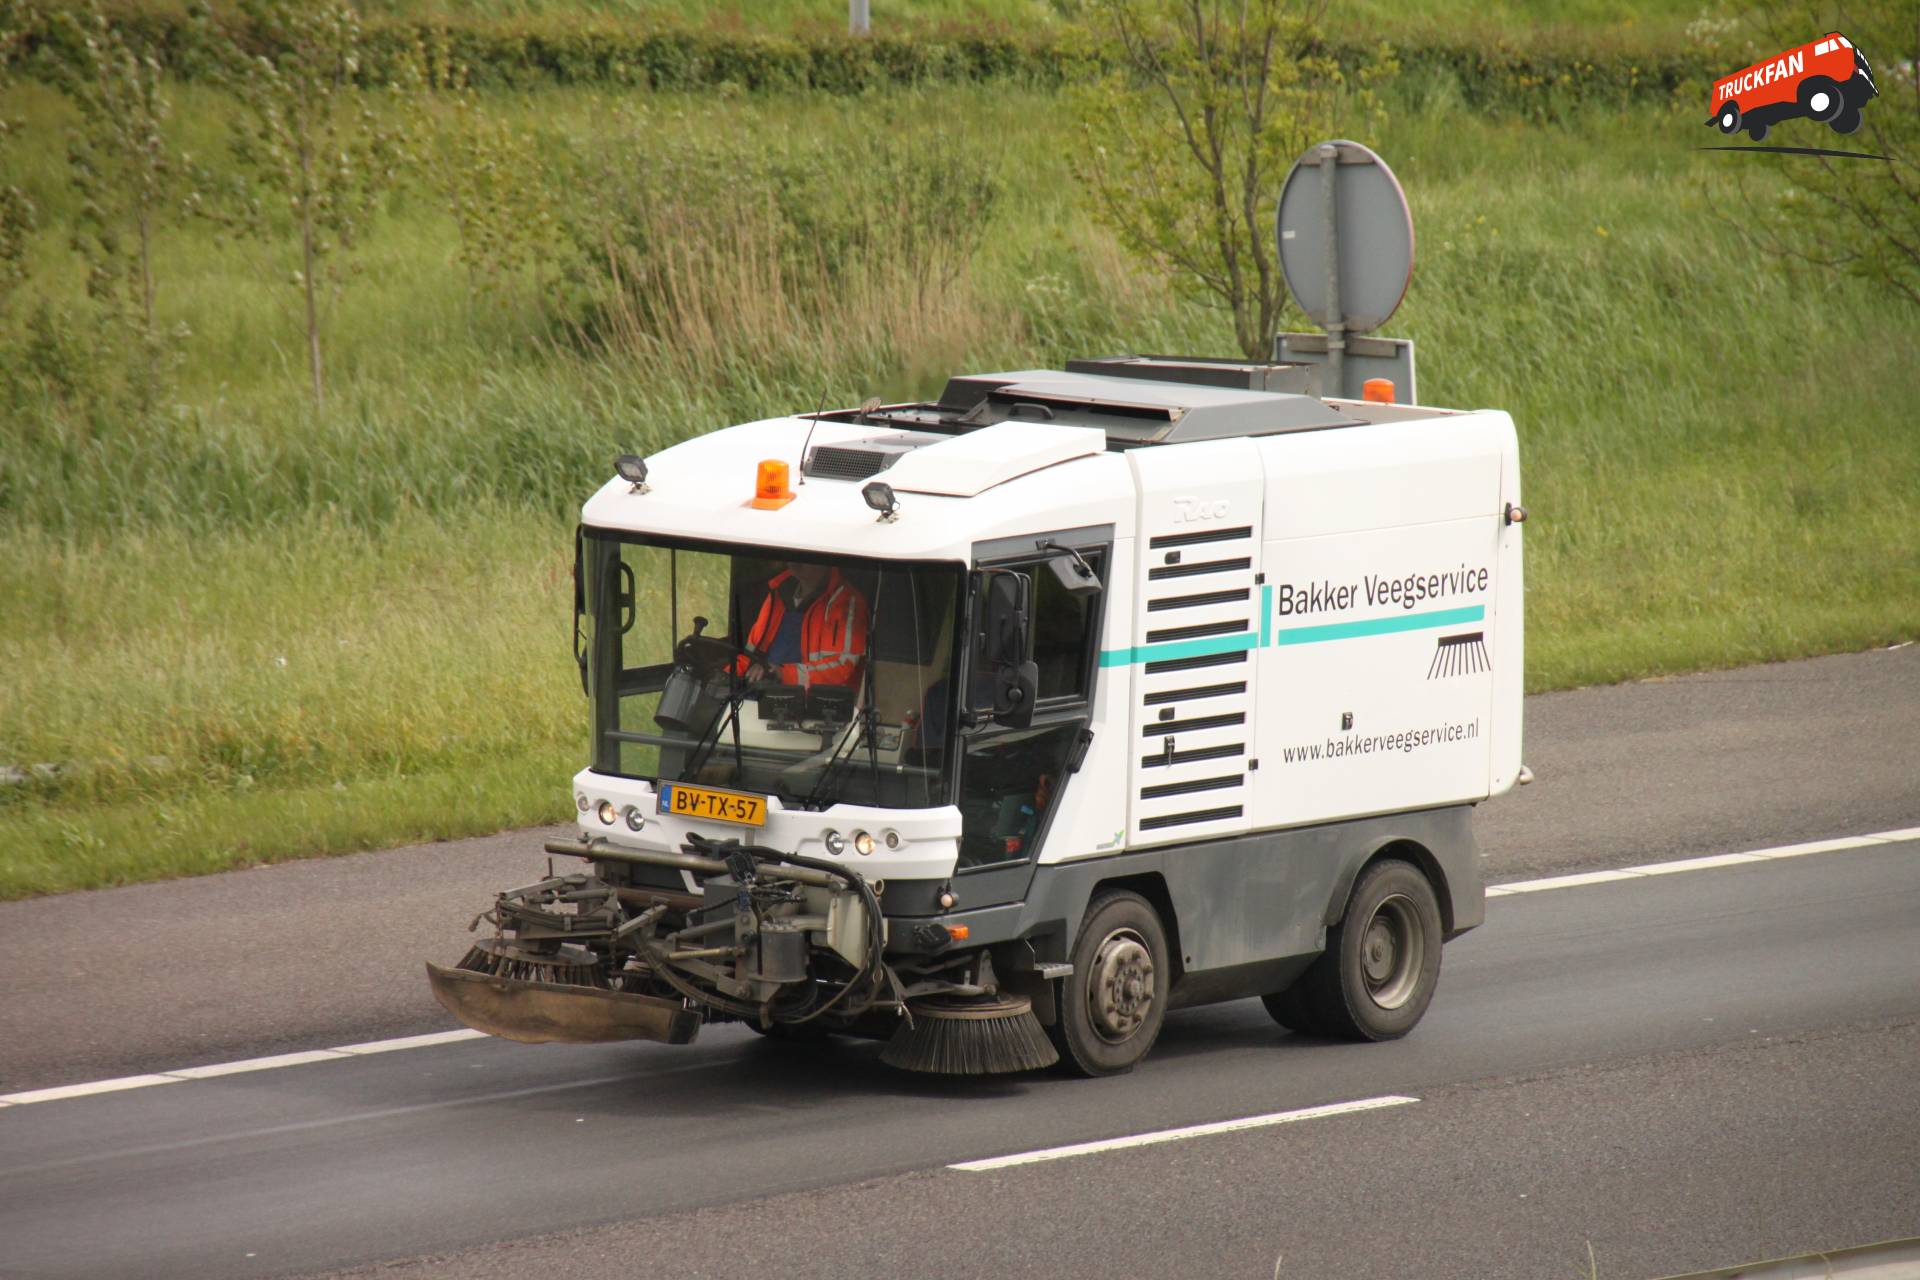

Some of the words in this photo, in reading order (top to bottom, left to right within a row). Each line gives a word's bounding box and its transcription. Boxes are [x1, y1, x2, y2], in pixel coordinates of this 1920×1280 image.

[1279, 580, 1358, 616] Bakker
[1364, 563, 1488, 610] Veegservice
[1283, 717, 1479, 763] www.bakkerveegservice.nl
[677, 791, 757, 820] BV-TX-57
